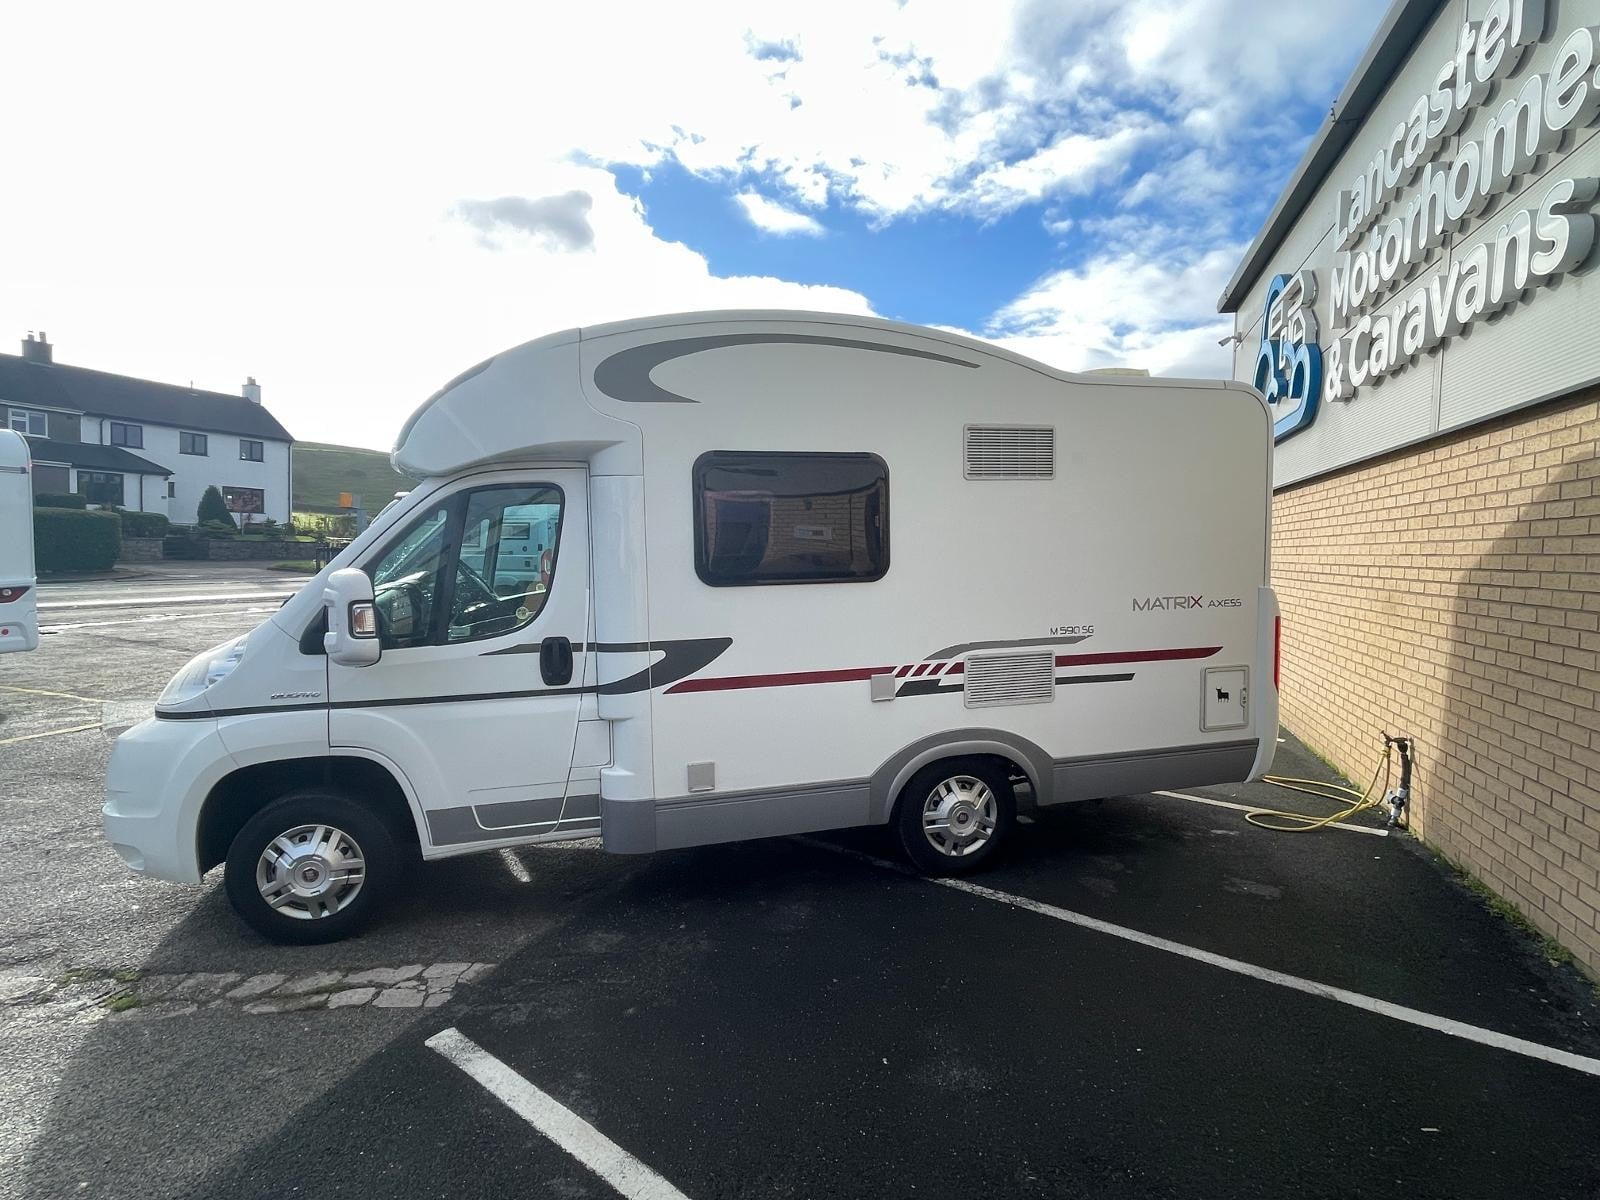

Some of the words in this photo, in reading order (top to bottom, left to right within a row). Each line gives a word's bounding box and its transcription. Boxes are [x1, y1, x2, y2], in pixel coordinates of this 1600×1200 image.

[1325, 338, 1344, 402] &
[1348, 178, 1575, 387] Caravans
[1132, 595, 1203, 612] MATRIX
[1207, 599, 1242, 608] AXESS
[1050, 627, 1058, 635] M
[1059, 626, 1080, 635] 590
[1082, 625, 1094, 634] SG
